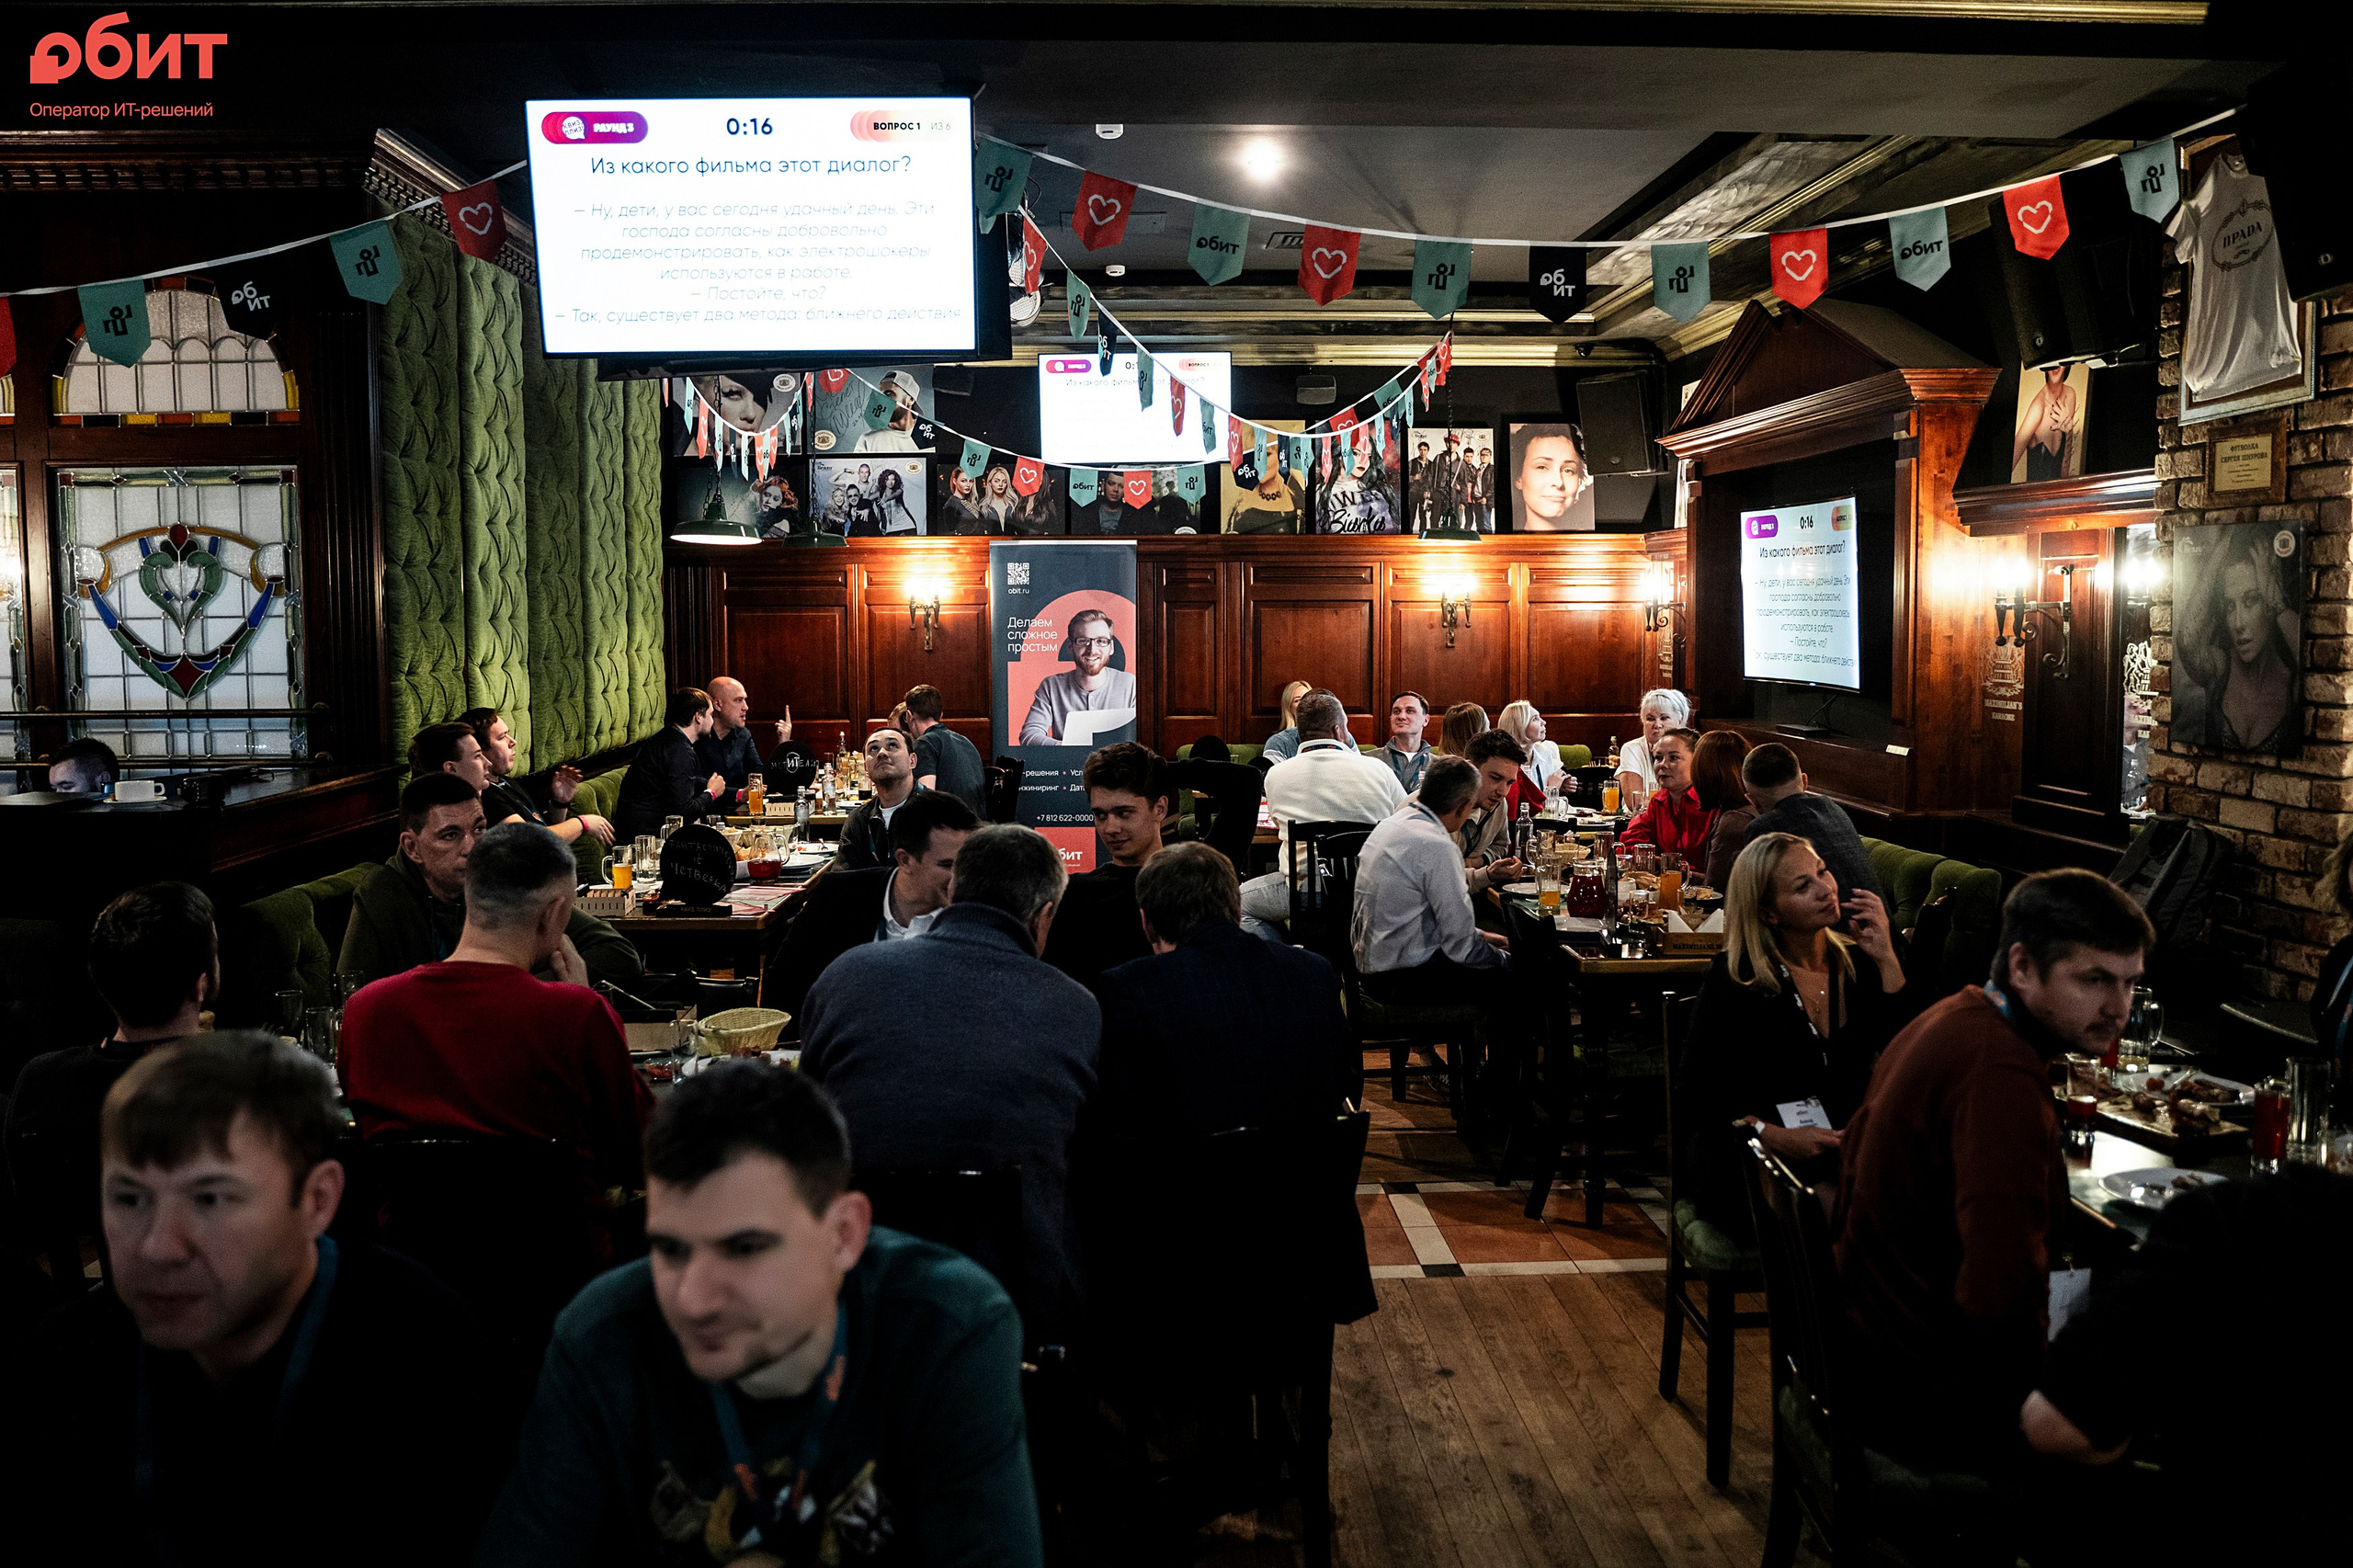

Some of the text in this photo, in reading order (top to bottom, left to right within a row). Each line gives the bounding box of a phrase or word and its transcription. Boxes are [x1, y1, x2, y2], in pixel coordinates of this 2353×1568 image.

[594, 122, 633, 134] РАУНД 3
[725, 118, 774, 136] 0:16
[873, 121, 921, 131] ВОПРОС 1
[930, 121, 950, 131] ИЗ 6
[591, 155, 911, 177] Из какого фильма этот диалог?
[591, 203, 613, 220] Ну,
[618, 205, 660, 219] дети,
[664, 205, 675, 220] у
[678, 204, 708, 216] вас
[712, 204, 778, 218] сегодня
[782, 201, 853, 220] удачный
[857, 203, 899, 217] день.
[904, 201, 935, 214] Эти
[621, 222, 888, 240] господа согласны добровольно
[1196, 235, 1239, 255] обит
[1900, 240, 1943, 260] обит
[581, 244, 931, 263] продемонстрировать, как электрошокеры
[660, 264, 852, 283] используются в работе.
[707, 287, 786, 301] Постойте,
[791, 285, 826, 300] что?
[572, 308, 601, 325] Так,
[606, 308, 699, 325] существует
[704, 309, 733, 323] два
[739, 308, 801, 323] метода:
[805, 306, 883, 321] ближнего
[1073, 482, 1095, 491] обит
[1800, 516, 1813, 529] 0:16
[1760, 540, 1845, 559] Из какого фильма этот диалог?
[1007, 617, 1052, 629] Делаем
[1007, 630, 1058, 640] сложное
[1007, 642, 1058, 654] простым
[1022, 770, 1060, 778] -решения
[1018, 785, 1060, 793] нжиниринг
[1059, 847, 1084, 861] бит
